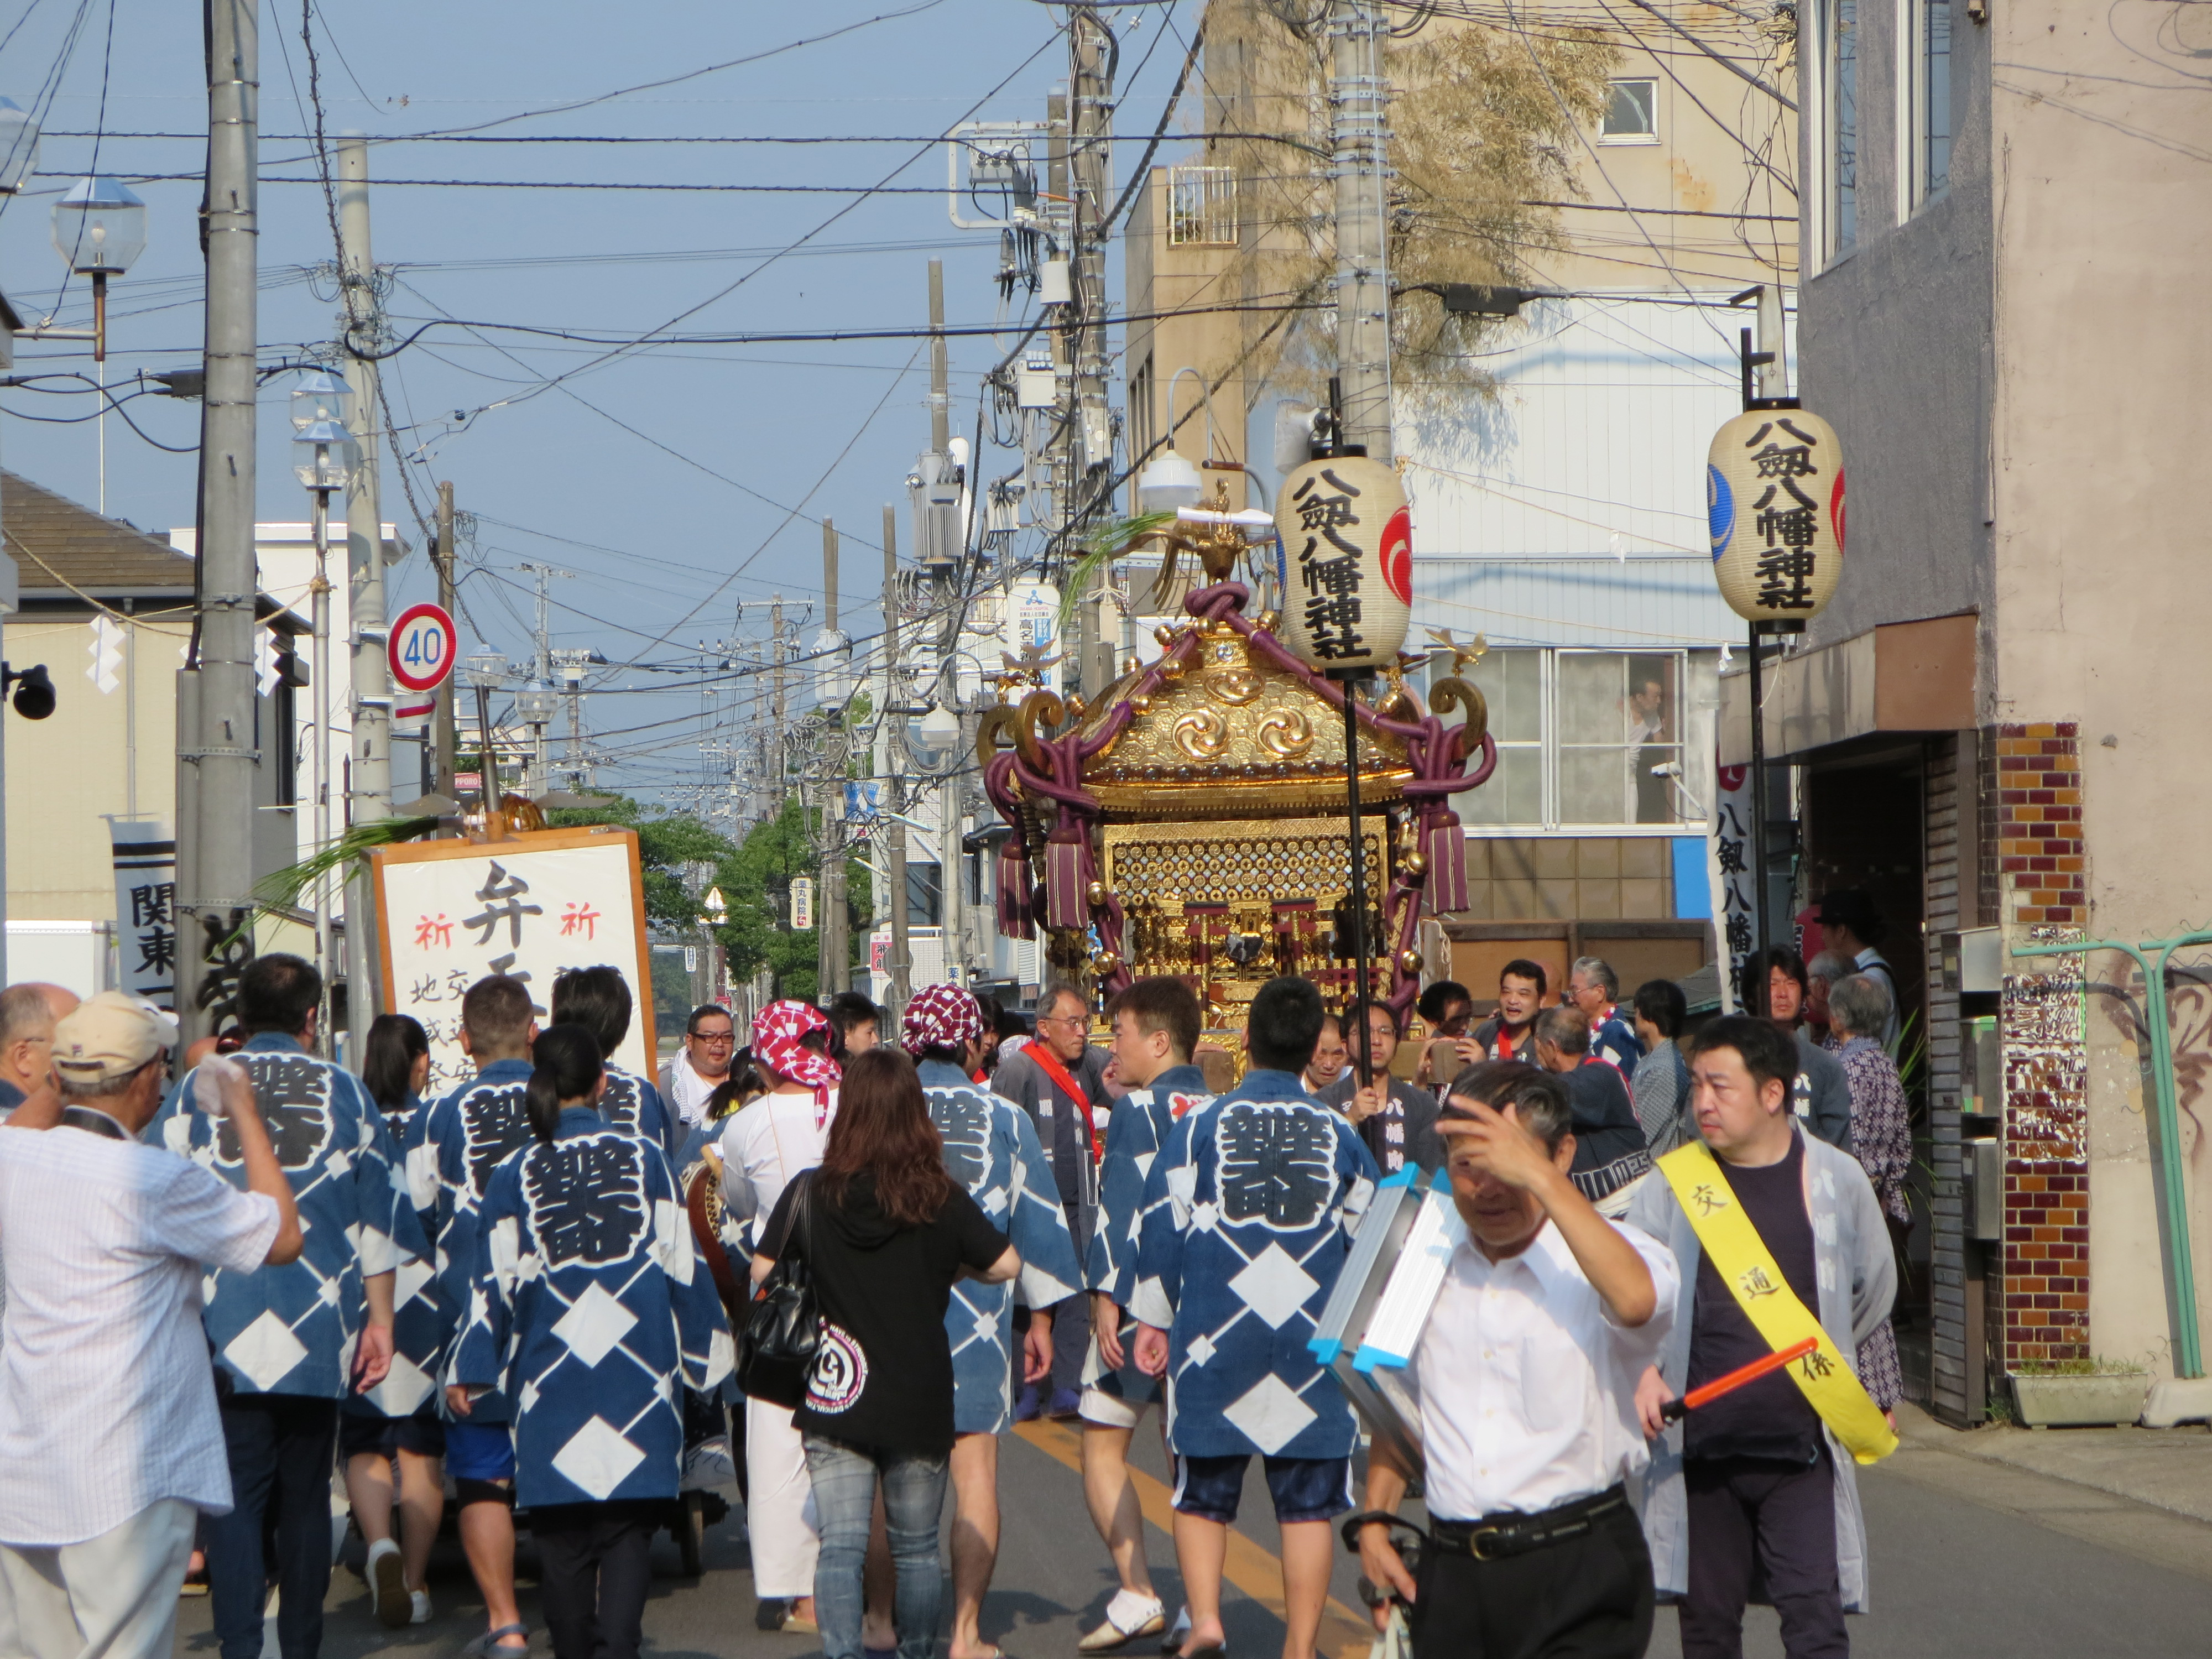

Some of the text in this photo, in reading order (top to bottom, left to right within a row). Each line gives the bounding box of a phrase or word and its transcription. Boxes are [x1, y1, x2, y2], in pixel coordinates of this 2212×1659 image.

[404, 628, 441, 666] 40
[798, 880, 807, 915] 薬丸病院
[414, 912, 455, 951] 祈
[560, 901, 601, 941] 祈
[948, 967, 959, 984] 薬
